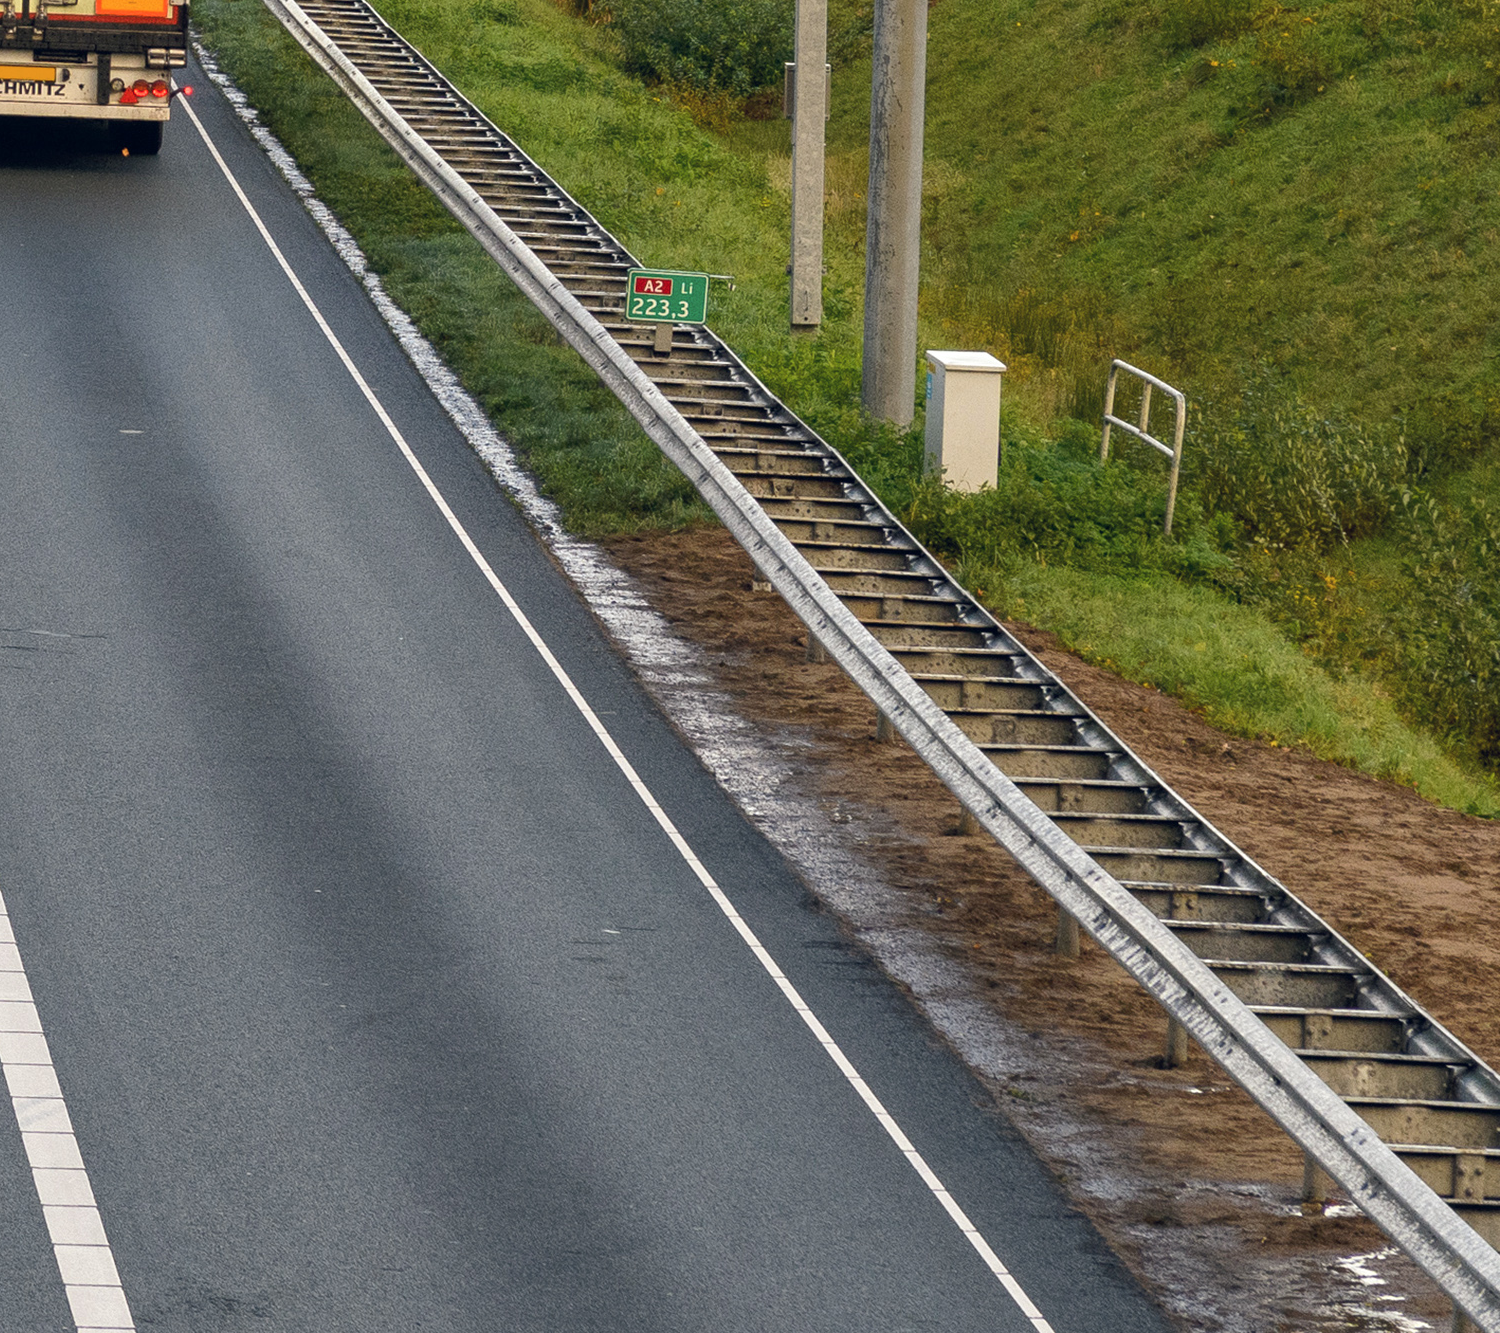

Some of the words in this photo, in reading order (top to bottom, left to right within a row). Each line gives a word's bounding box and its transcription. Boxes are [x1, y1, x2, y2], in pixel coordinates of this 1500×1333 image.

[644, 280, 663, 292] A2
[681, 282, 693, 294] Li
[632, 298, 689, 319] 223,3
